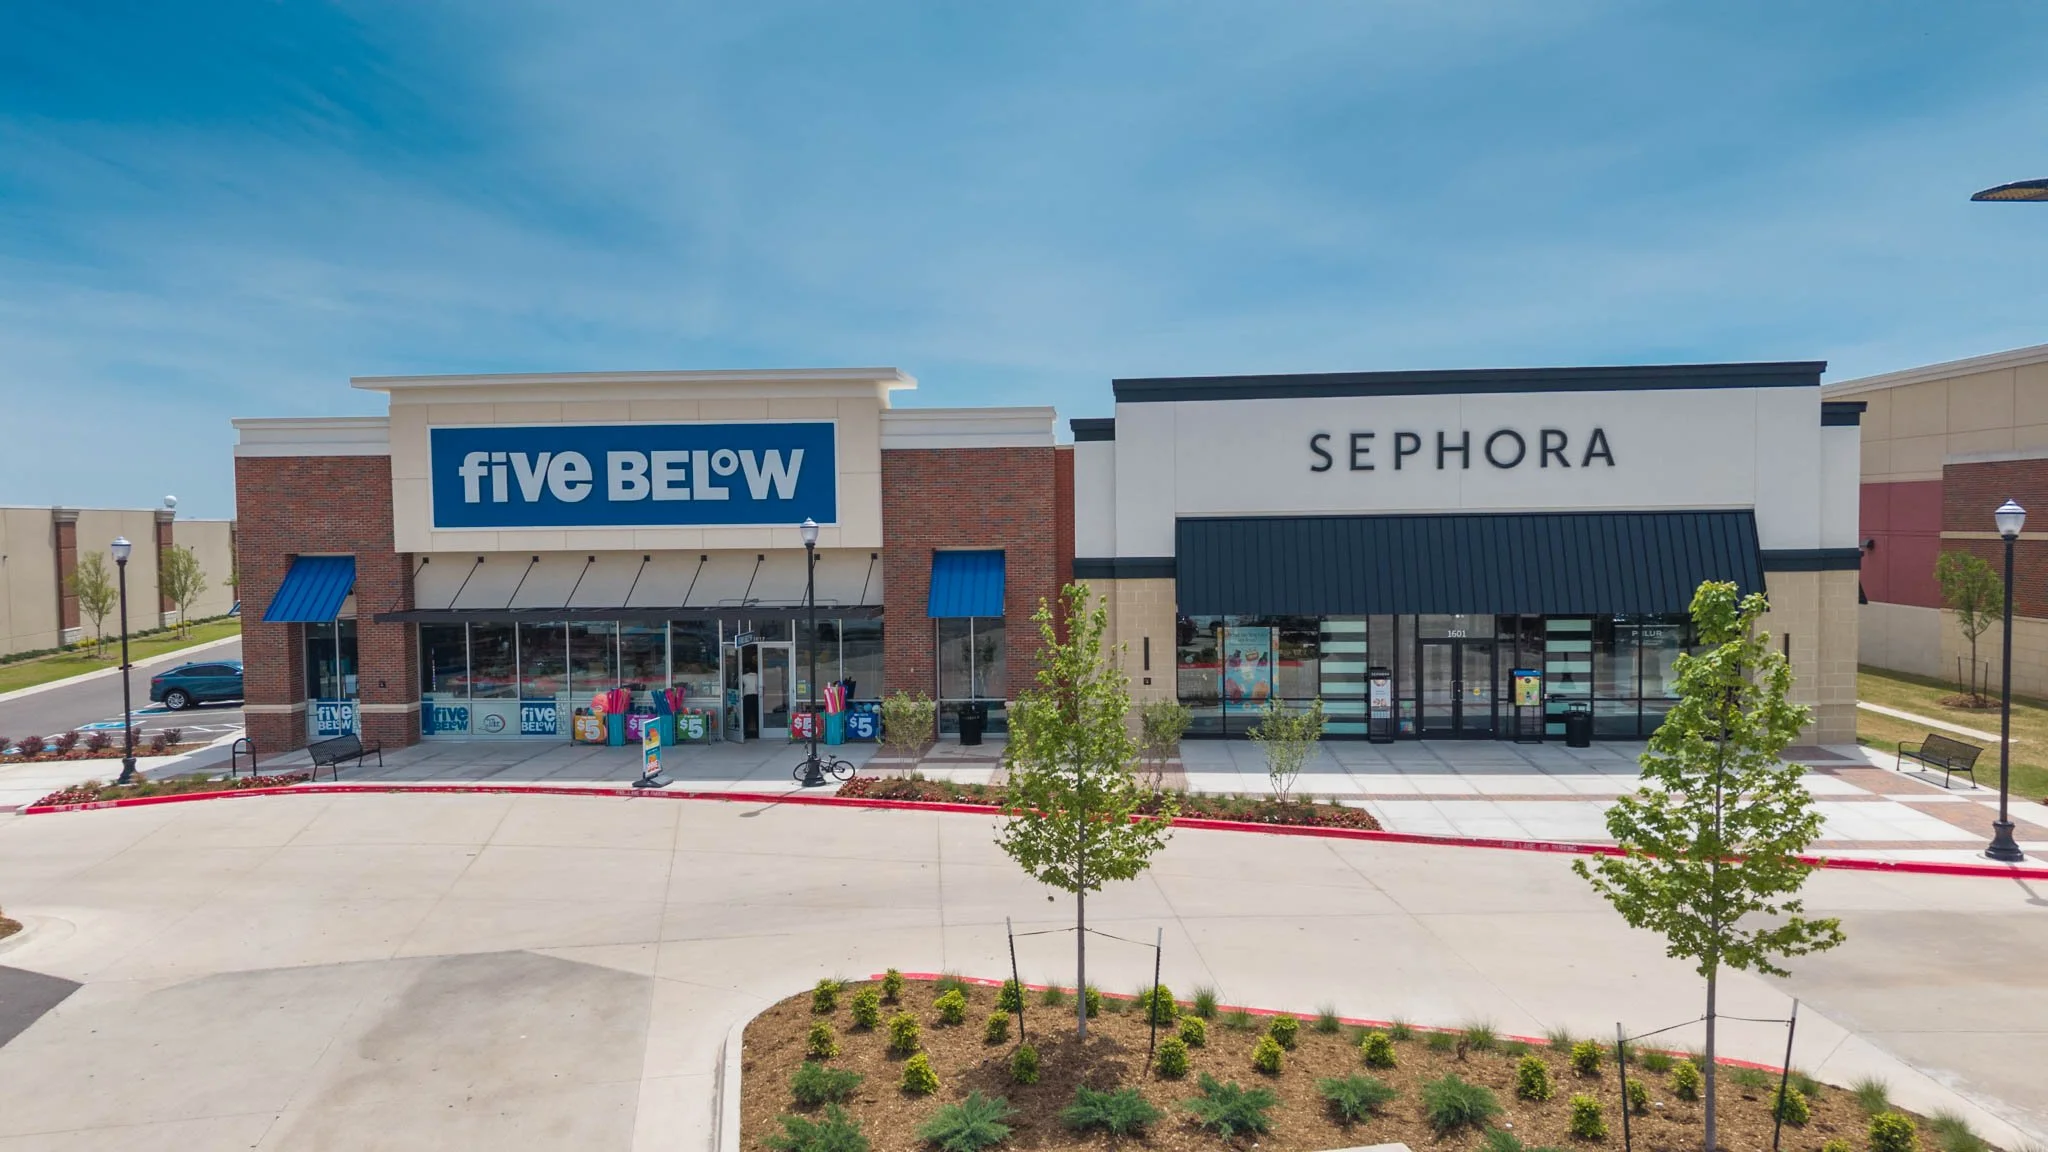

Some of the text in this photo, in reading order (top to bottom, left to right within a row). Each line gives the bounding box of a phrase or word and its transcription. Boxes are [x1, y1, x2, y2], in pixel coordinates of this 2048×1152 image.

[1310, 428, 1615, 472] SEPHORA
[459, 449, 805, 503] five BELOW
[1447, 630, 1466, 638] 1601
[318, 706, 352, 720] five
[434, 706, 468, 721] five
[521, 707, 556, 722] five
[521, 722, 555, 731] BELOW
[577, 719, 601, 740] $5
[680, 718, 704, 739] $5
[849, 717, 873, 737] $5
